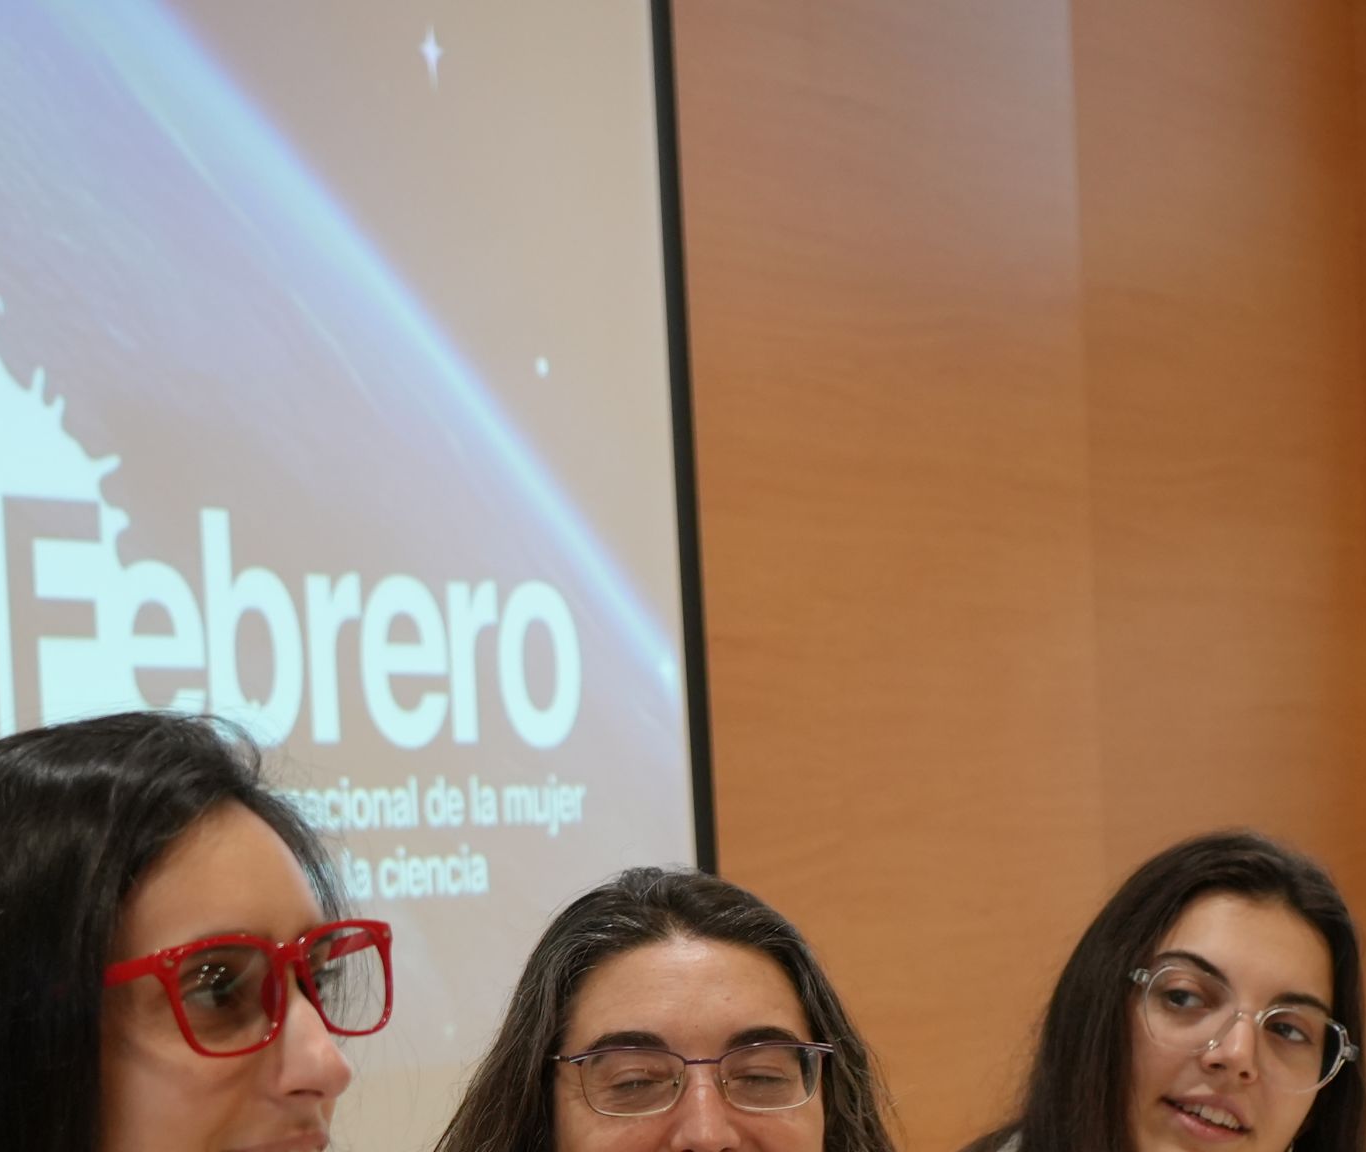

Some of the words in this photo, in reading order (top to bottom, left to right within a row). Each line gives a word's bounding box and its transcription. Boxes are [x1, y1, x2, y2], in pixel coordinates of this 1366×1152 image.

[425, 775, 465, 827] de
[469, 775, 498, 825] la
[502, 773, 587, 836] mujer
[377, 845, 489, 899] ciencia
